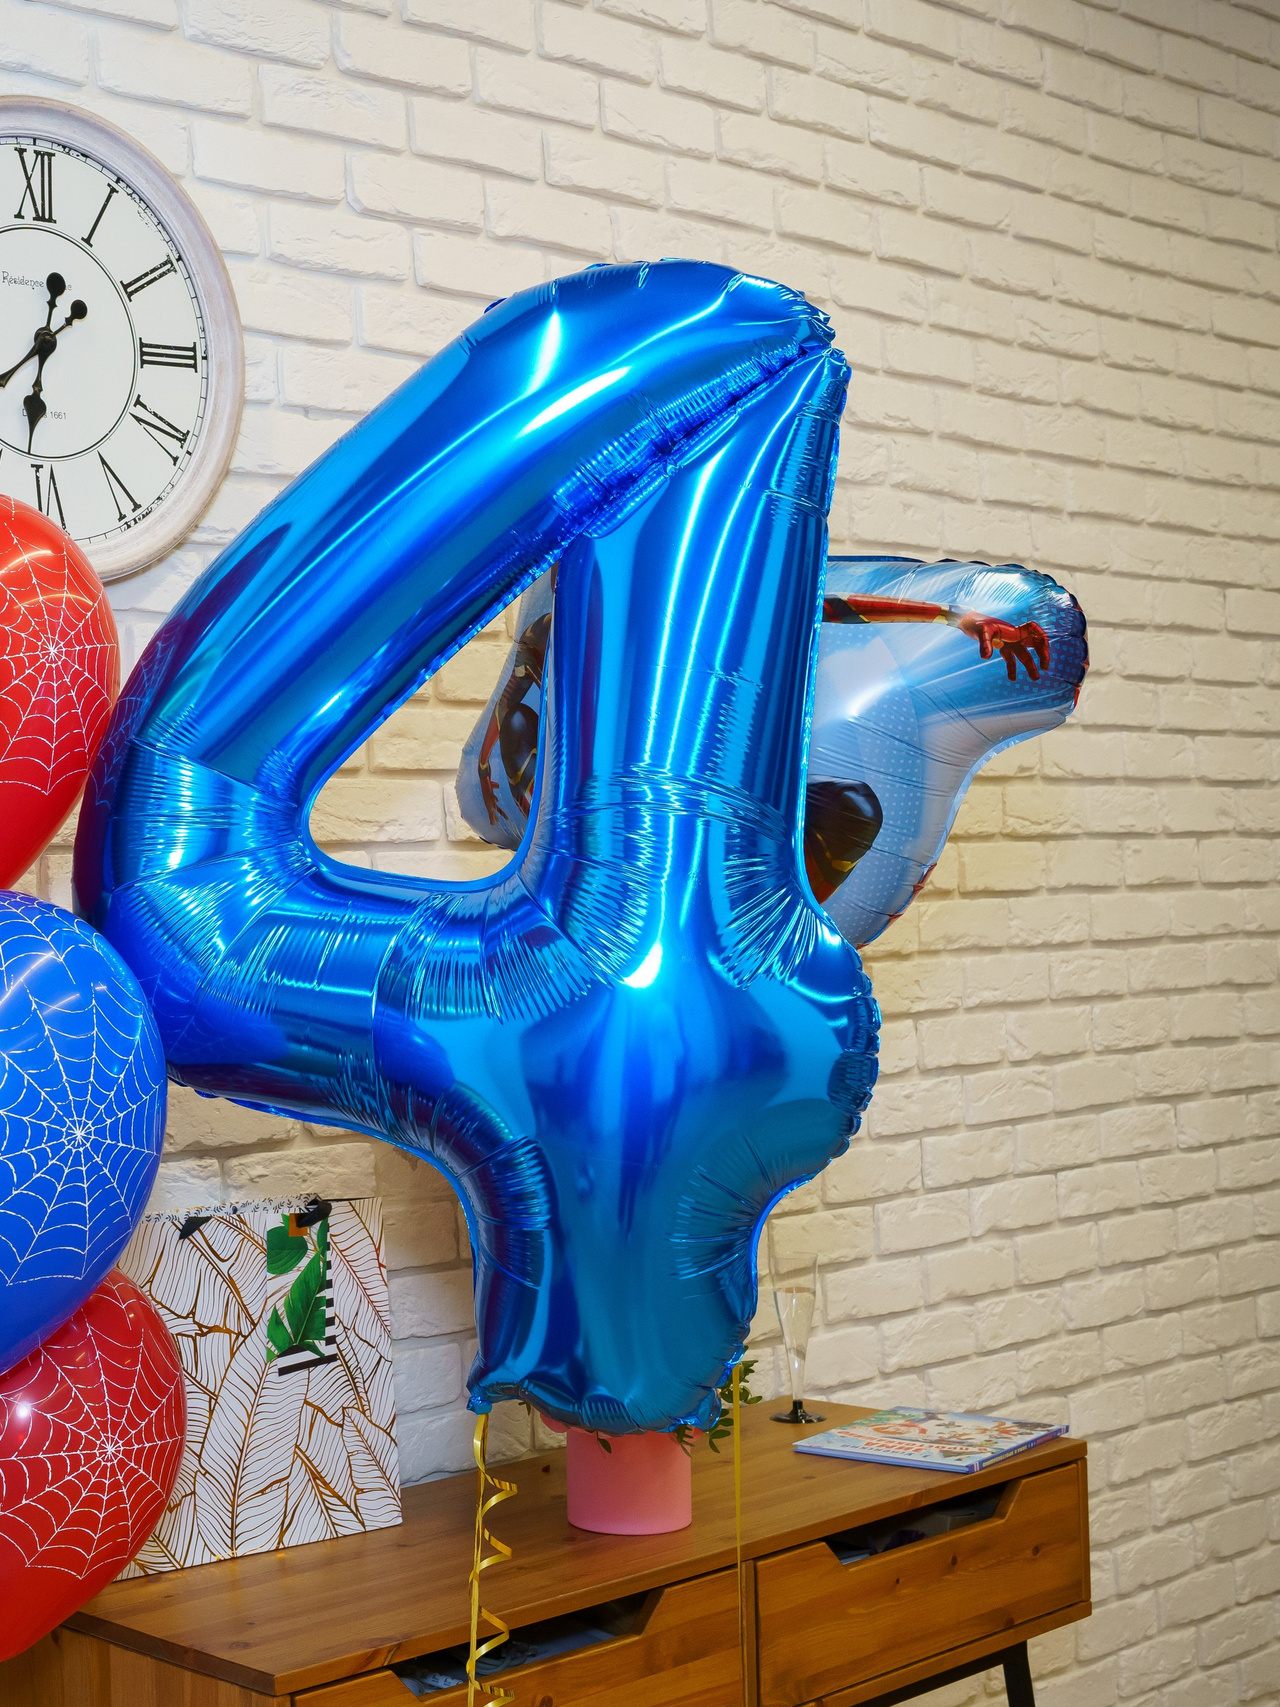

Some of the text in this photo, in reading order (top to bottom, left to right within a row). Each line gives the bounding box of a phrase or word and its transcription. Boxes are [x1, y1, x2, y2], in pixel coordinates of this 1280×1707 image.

[14, 147, 57, 224] XII
[81, 183, 119, 248] I
[1, 271, 45, 290] Résidence
[120, 253, 178, 302] II
[139, 337, 198, 373] III
[49, 411, 68, 420] 1661
[97, 450, 142, 521] V
